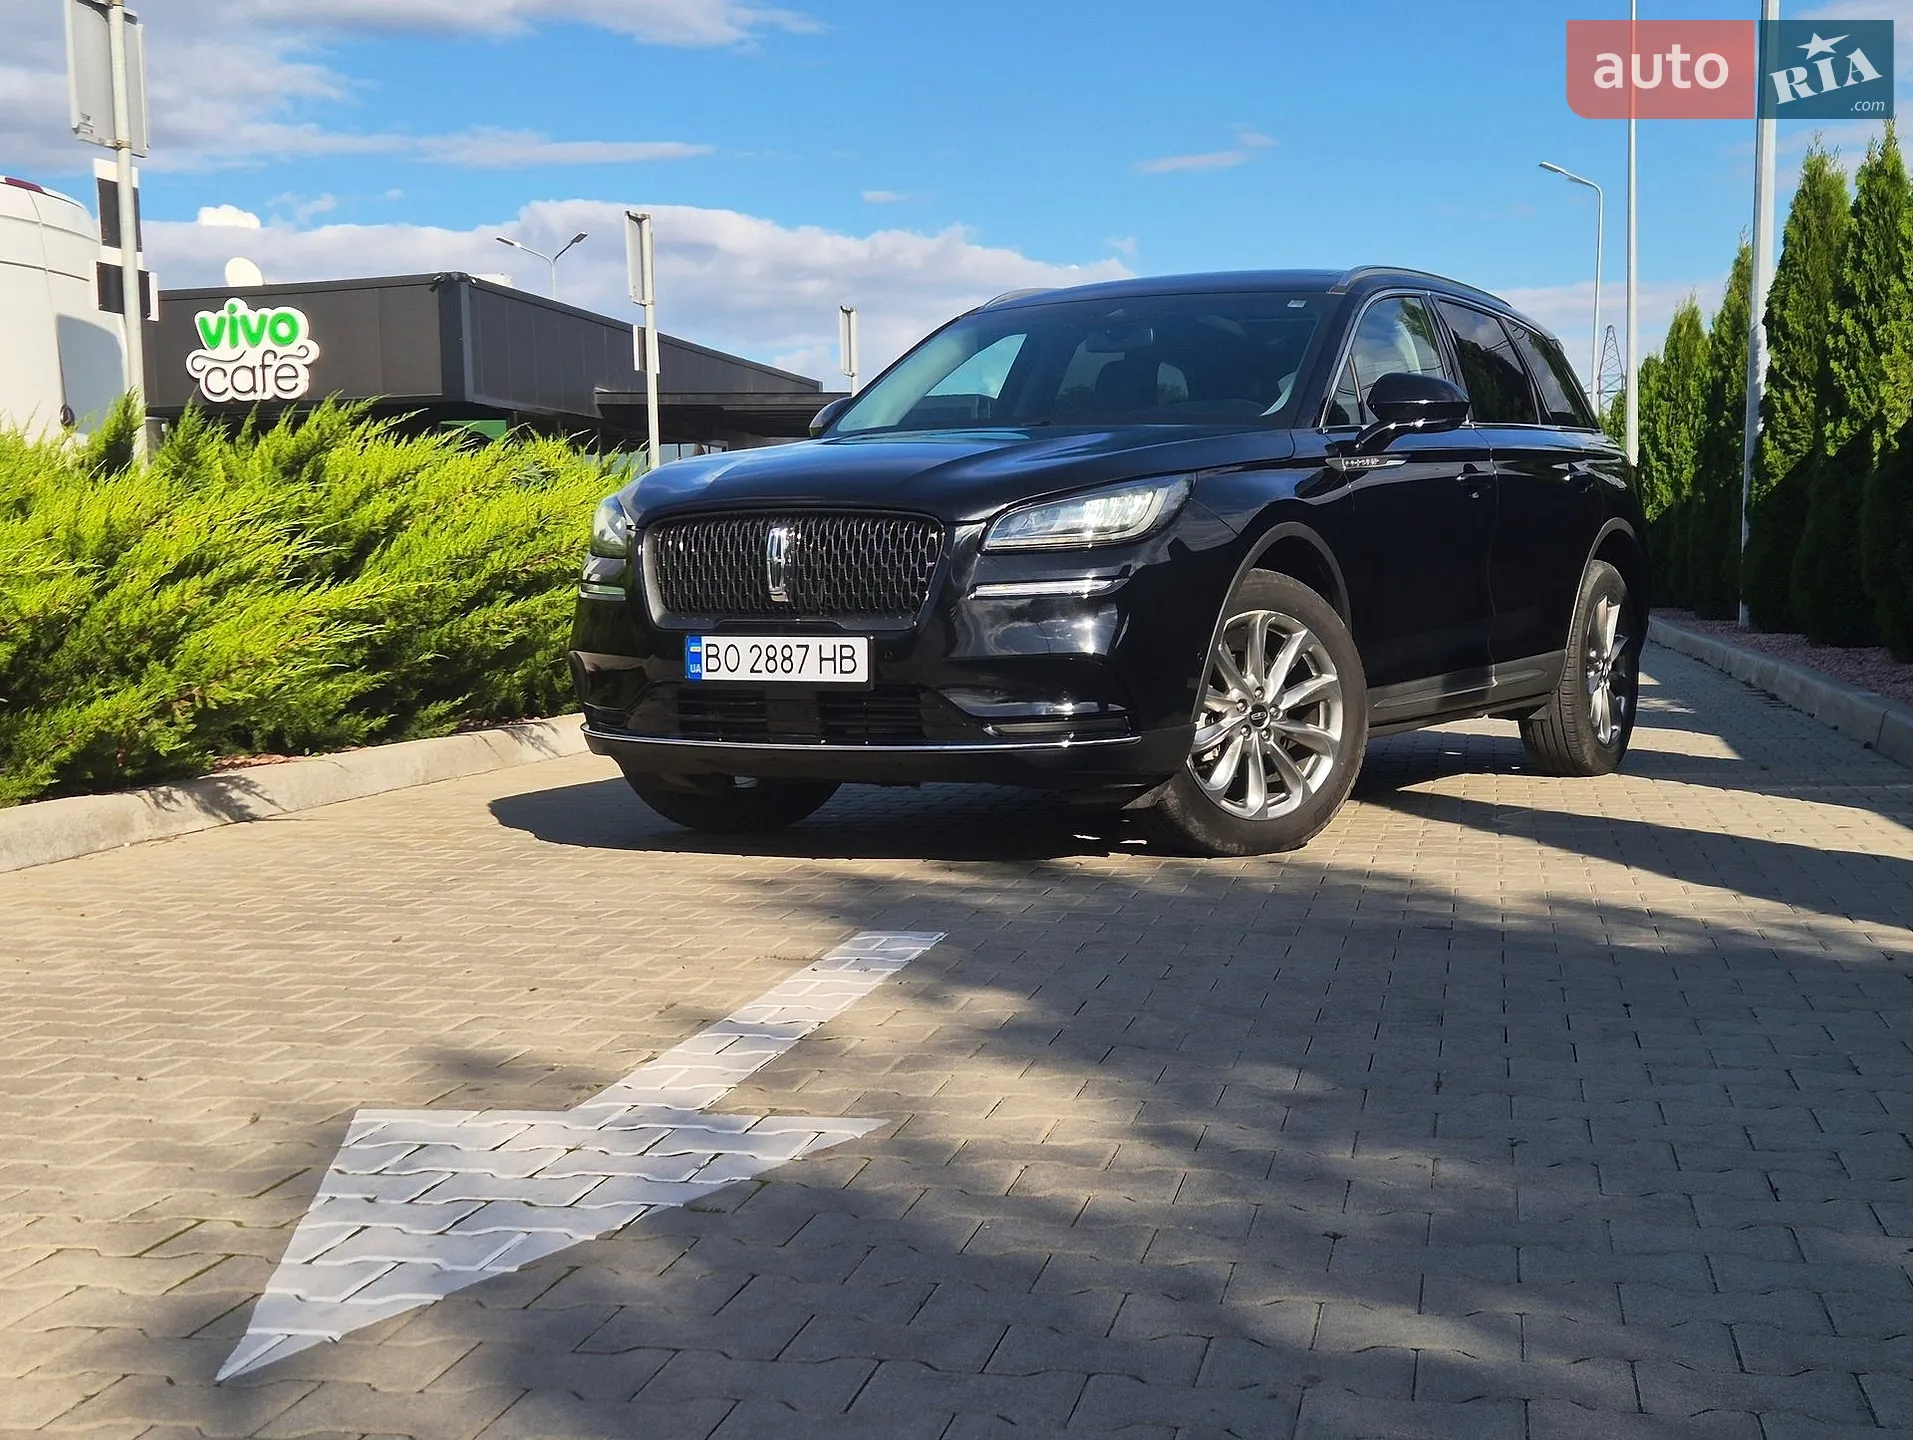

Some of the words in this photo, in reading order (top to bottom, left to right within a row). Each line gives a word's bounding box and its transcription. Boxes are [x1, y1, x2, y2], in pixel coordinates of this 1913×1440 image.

[198, 303, 299, 350] vivo
[689, 663, 701, 674] UA
[705, 643, 740, 673] BO
[749, 644, 810, 674] 2887
[818, 644, 857, 674] HB
